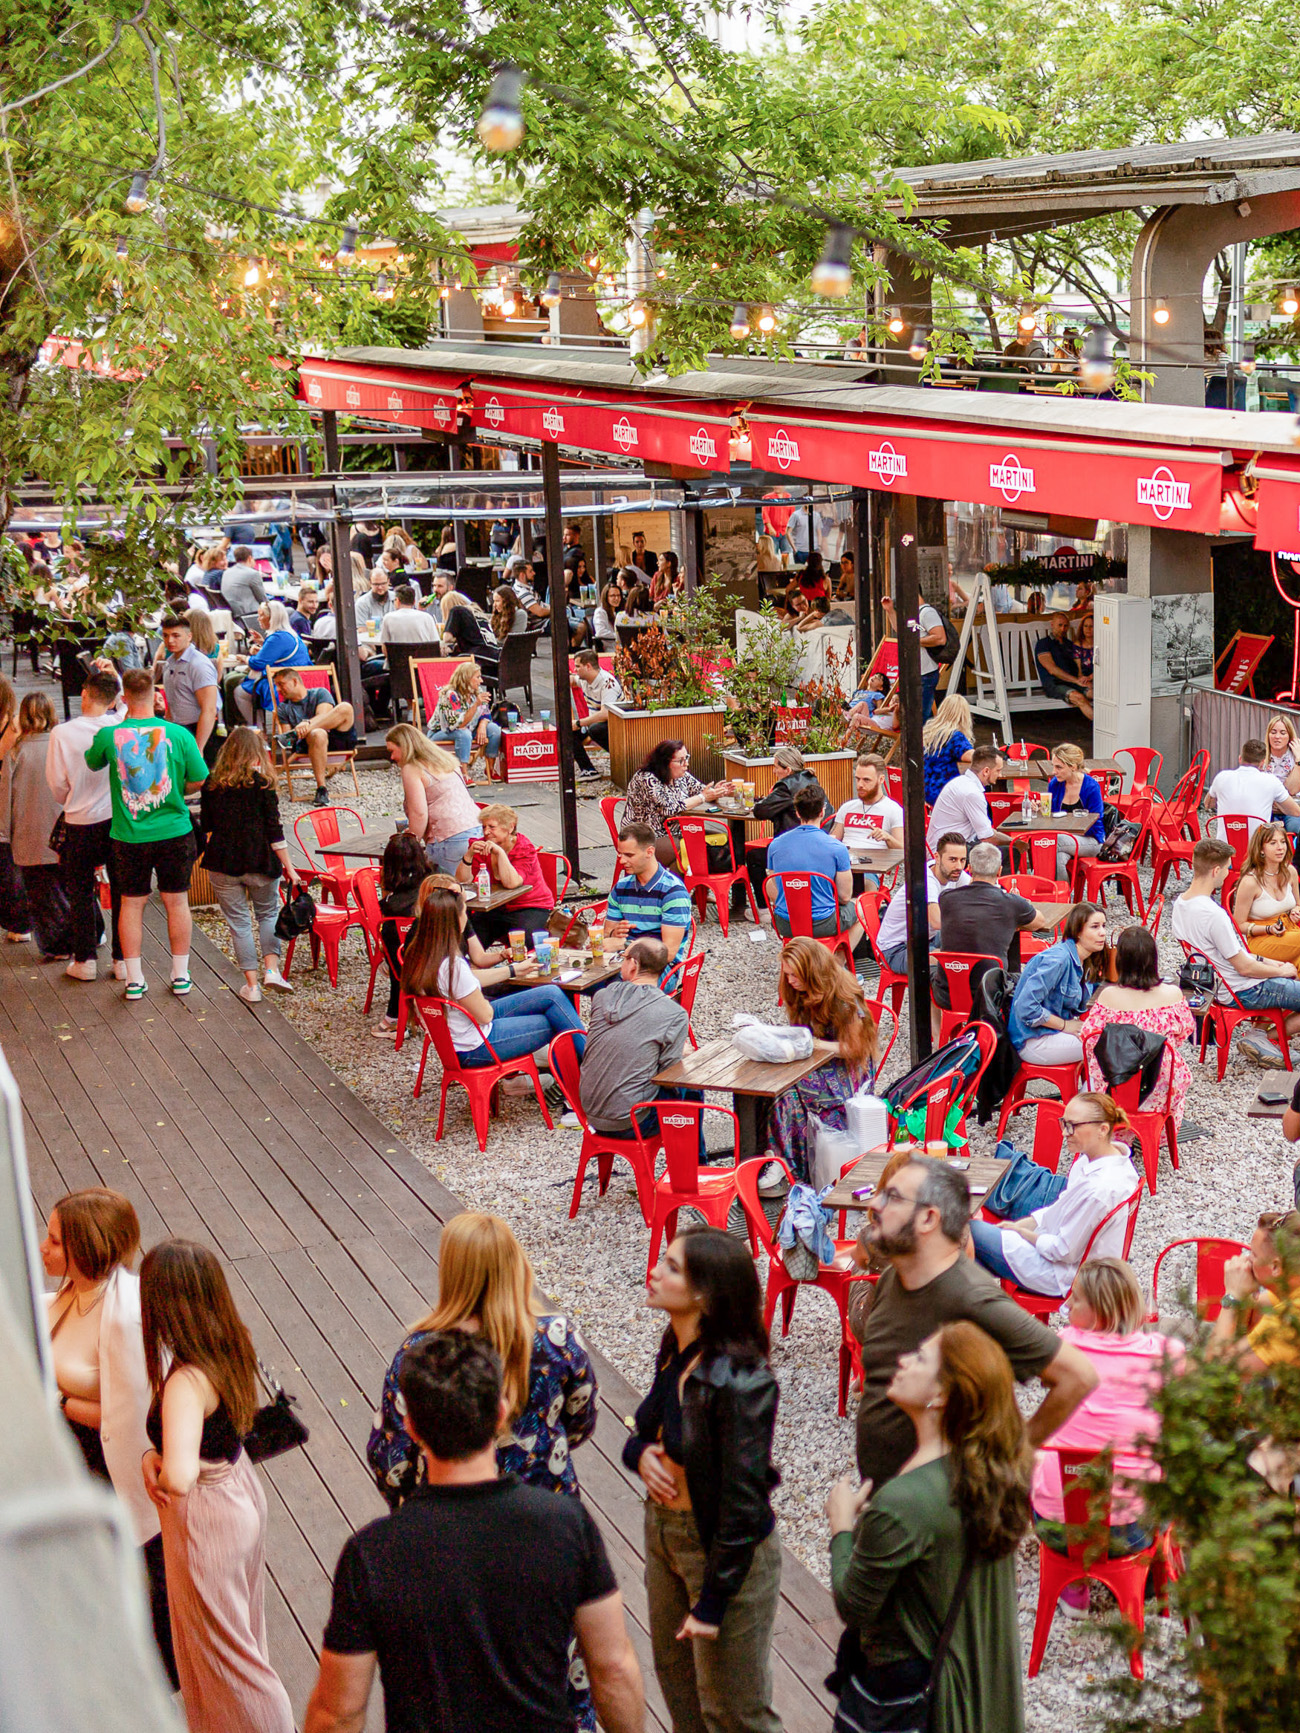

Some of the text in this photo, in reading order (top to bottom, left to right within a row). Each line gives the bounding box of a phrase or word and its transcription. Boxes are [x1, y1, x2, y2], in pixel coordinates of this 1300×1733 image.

[544, 414, 564, 430] MARTINI
[614, 426, 637, 443] MARTINI
[691, 438, 715, 456] MARTINI
[770, 440, 798, 458] MARTINI
[871, 454, 904, 474] MARTINI
[992, 468, 1032, 489] MARTINI
[1140, 482, 1187, 507] MARTINI
[1039, 555, 1094, 570] MARTINI
[515, 746, 553, 755] MARTINI
